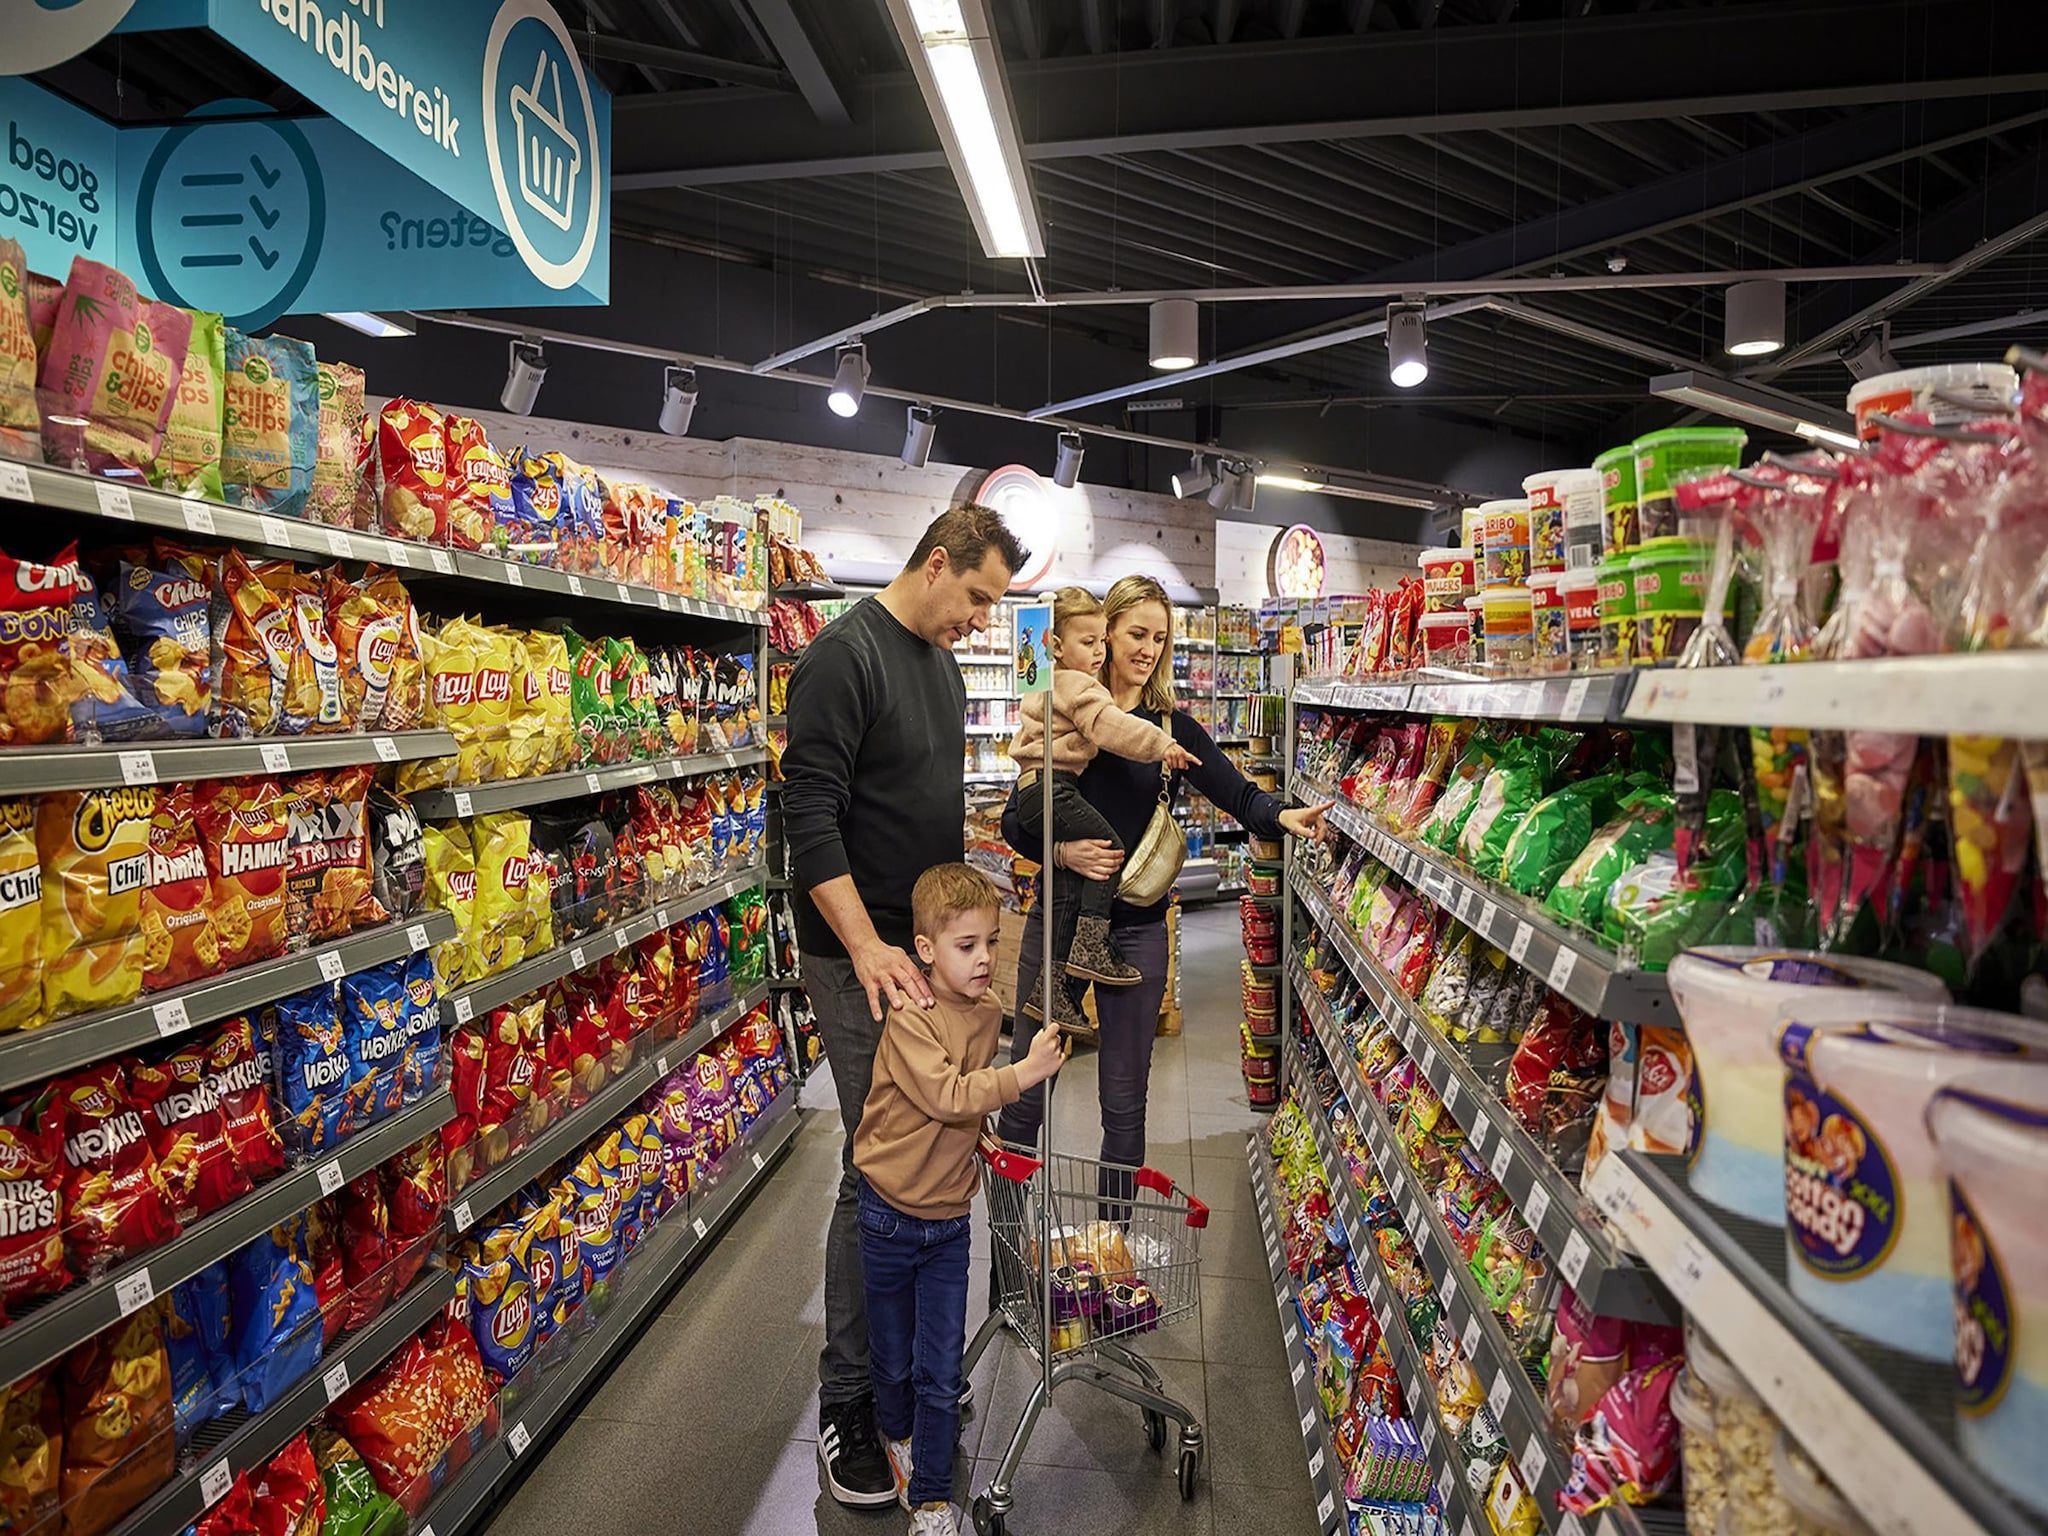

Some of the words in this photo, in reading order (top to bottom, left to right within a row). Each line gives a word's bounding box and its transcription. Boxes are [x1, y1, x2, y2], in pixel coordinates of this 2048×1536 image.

[261, 0, 460, 158] andbereik
[112, 350, 165, 391] chips
[225, 386, 286, 412] chips
[174, 609, 207, 632] CHIPS
[79, 787, 155, 849] Cheeto
[246, 895, 281, 911] Original
[166, 911, 207, 928] Original
[0, 1254, 31, 1269] heese
[0, 1265, 37, 1283] aprika
